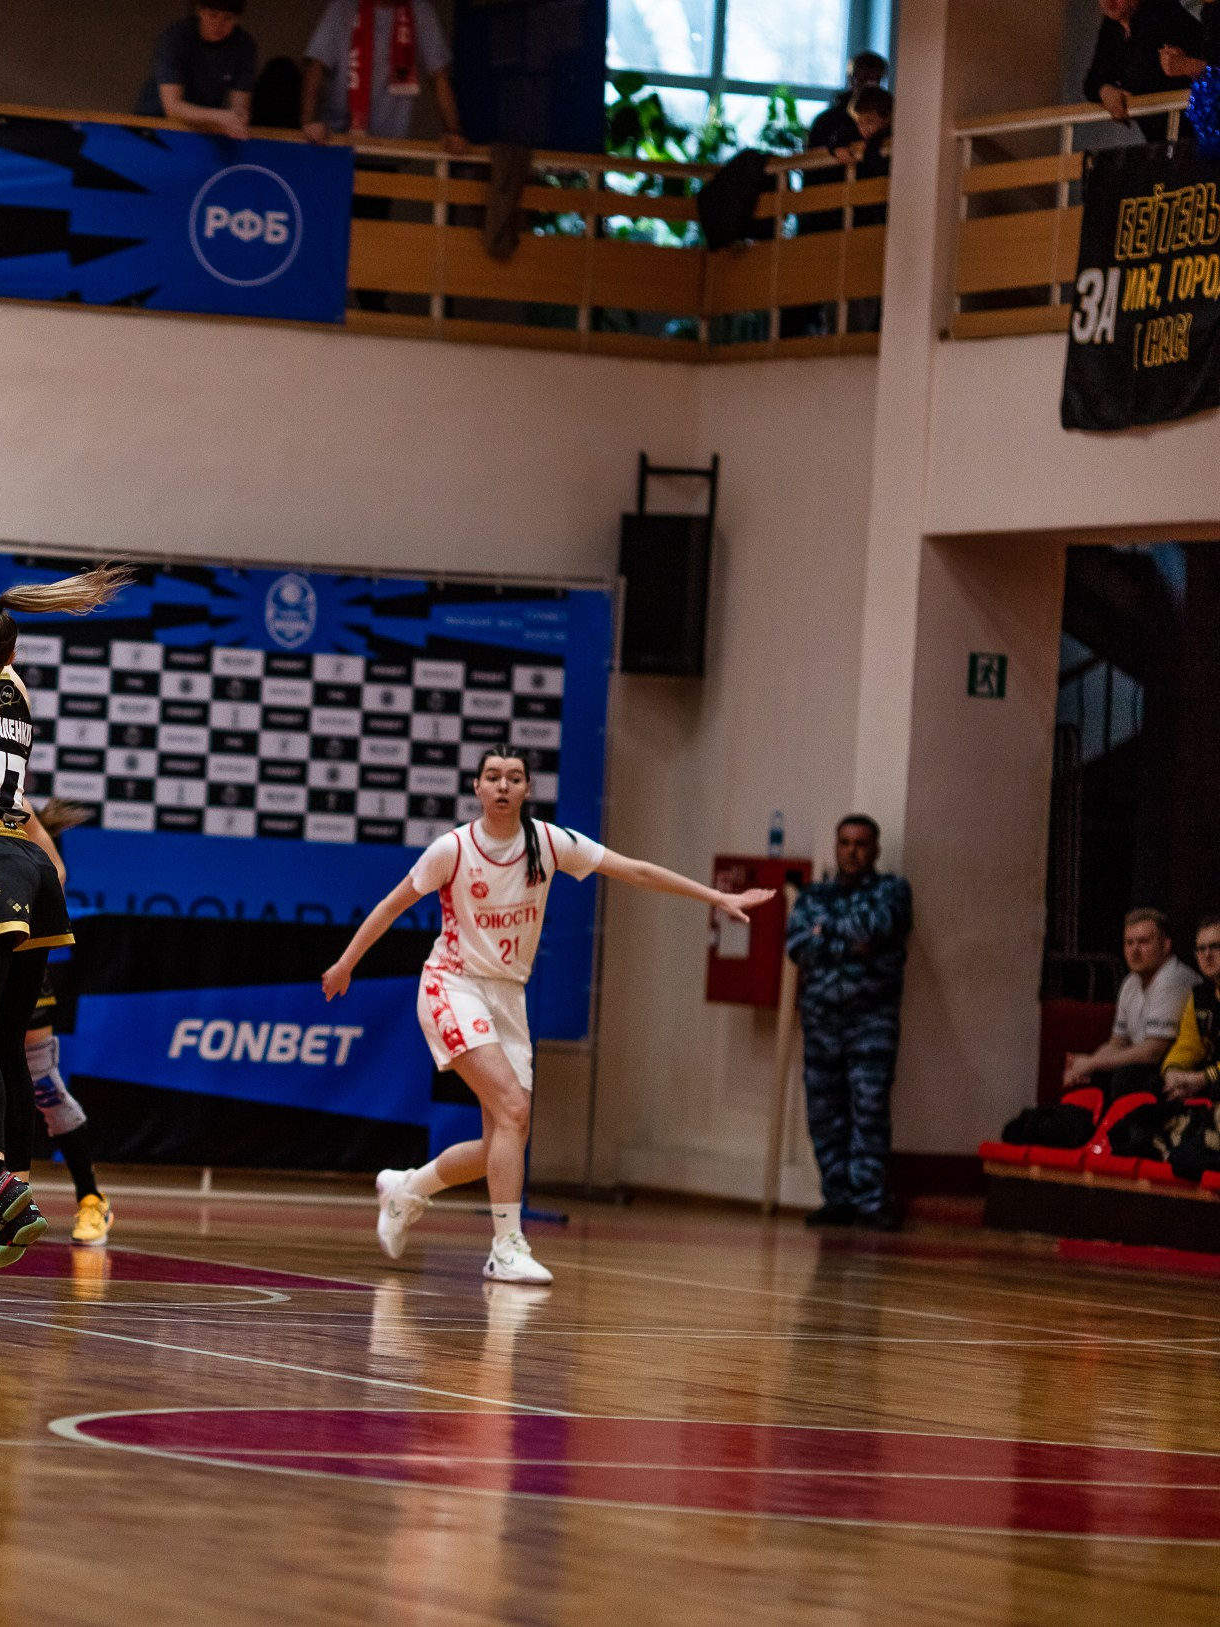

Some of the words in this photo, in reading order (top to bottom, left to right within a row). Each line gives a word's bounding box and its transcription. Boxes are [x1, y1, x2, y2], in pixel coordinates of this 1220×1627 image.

[204, 206, 289, 245] РФБ
[1168, 254, 1220, 302] ГОРО
[1073, 267, 1121, 345] ЗА
[499, 936, 519, 965] 21
[167, 1018, 364, 1067] FONBET
